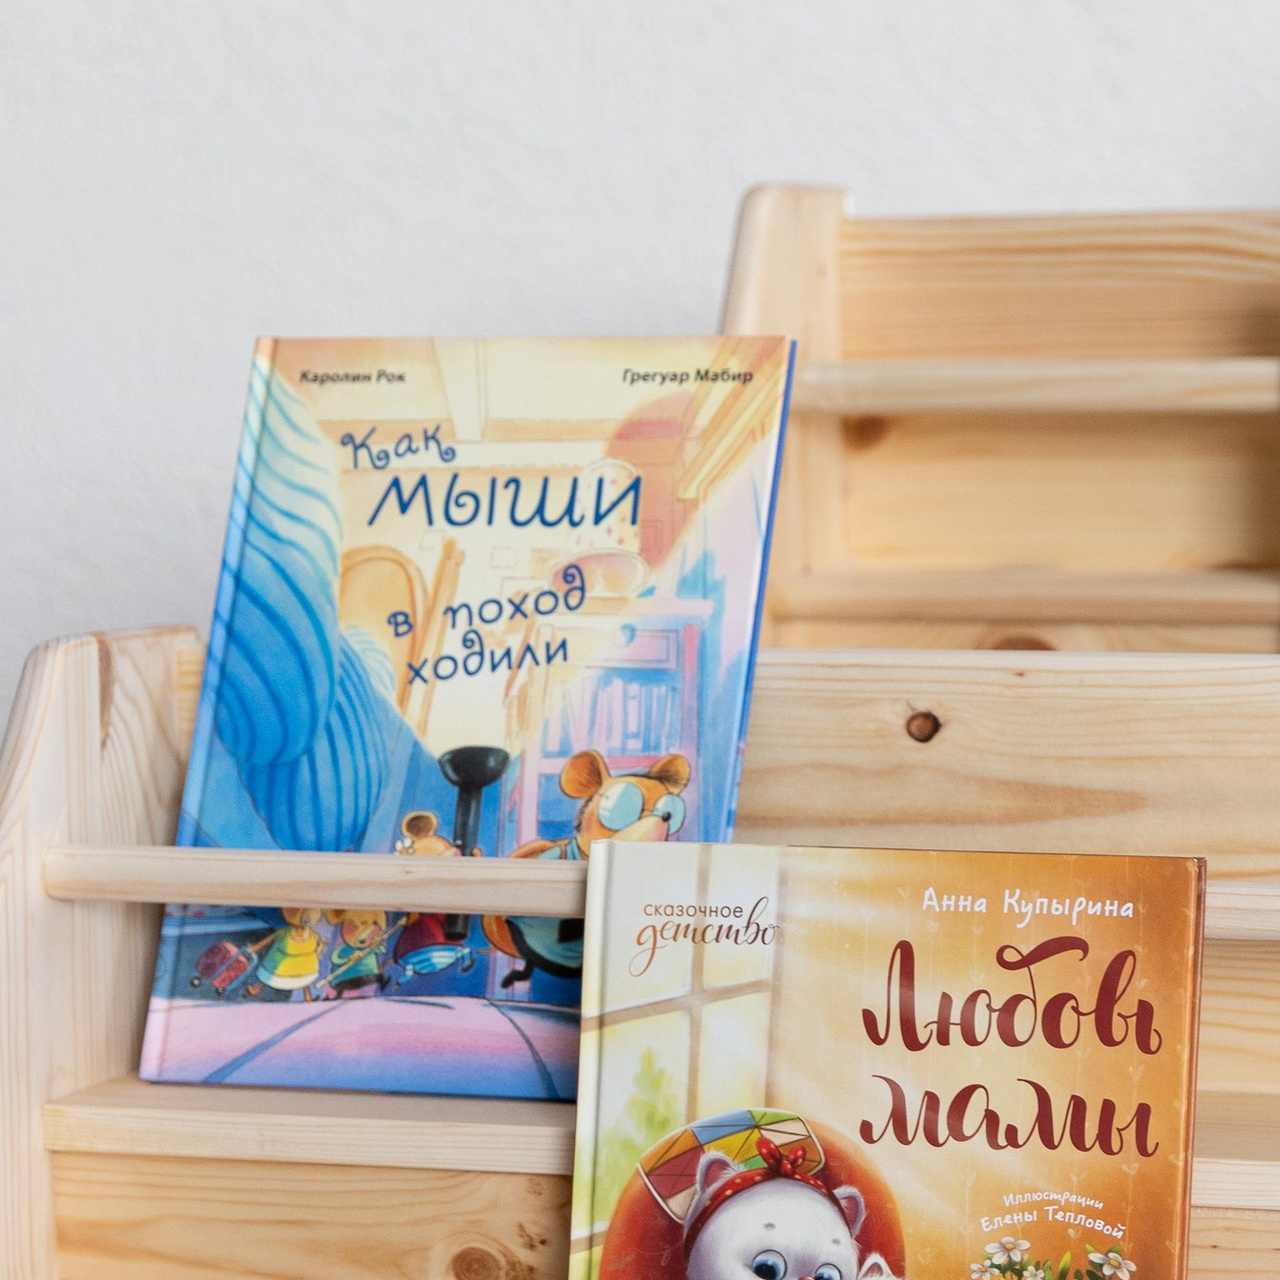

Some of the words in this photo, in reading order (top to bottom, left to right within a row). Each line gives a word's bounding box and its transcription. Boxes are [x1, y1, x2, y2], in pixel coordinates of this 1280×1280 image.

[299, 369, 372, 384] Каролин
[376, 369, 406, 384] Рок
[622, 368, 690, 386] Грегуар
[693, 368, 754, 386] Мабир
[341, 424, 456, 471] Как
[366, 473, 643, 527] МЫШИ
[387, 611, 414, 638] в
[442, 564, 587, 631] поход
[406, 628, 570, 687] ходили
[643, 903, 744, 919] сказочное
[921, 886, 988, 914] Анна
[1003, 888, 1135, 929] Купырина
[628, 896, 782, 977] детство
[861, 935, 1163, 1055] Любовь
[859, 1074, 1160, 1158] мамы
[980, 1210, 1038, 1232] Елены
[1044, 1205, 1126, 1239] Тепловой
[1003, 1191, 1104, 1210] Иллюстрации
